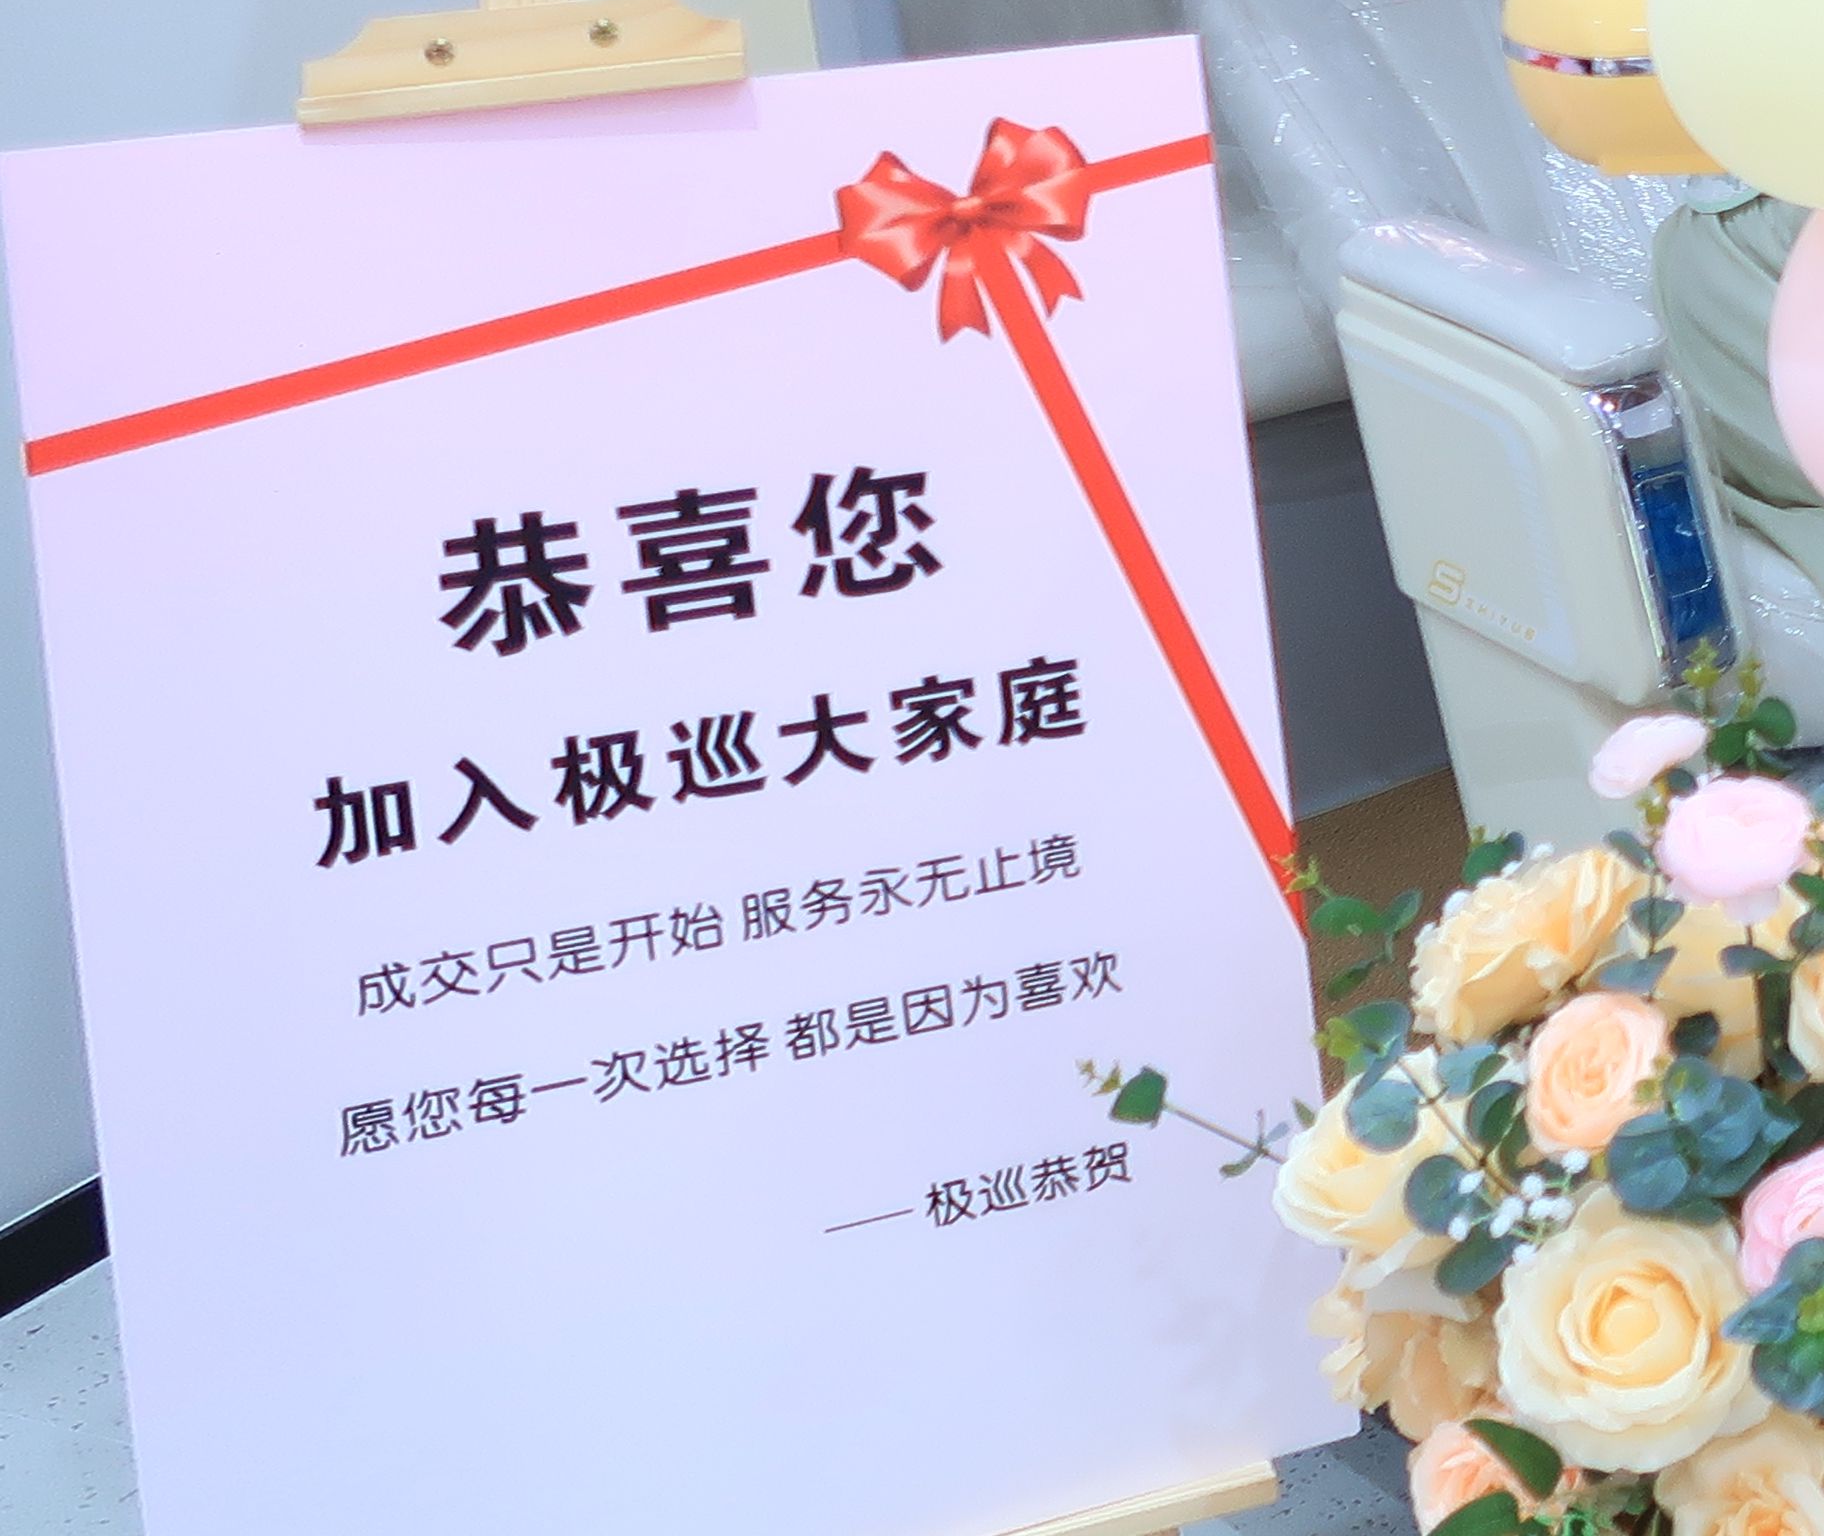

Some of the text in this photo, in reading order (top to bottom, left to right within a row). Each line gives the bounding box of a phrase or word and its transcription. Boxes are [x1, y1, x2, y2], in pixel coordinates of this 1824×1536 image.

[436, 464, 945, 658] 恭喜您
[312, 654, 1088, 870] 加入极巡大家庭
[356, 832, 1082, 1017] 成交只是开始 服务永无止境
[338, 949, 1124, 1158] 愿您每一次选择 都是因为喜欢
